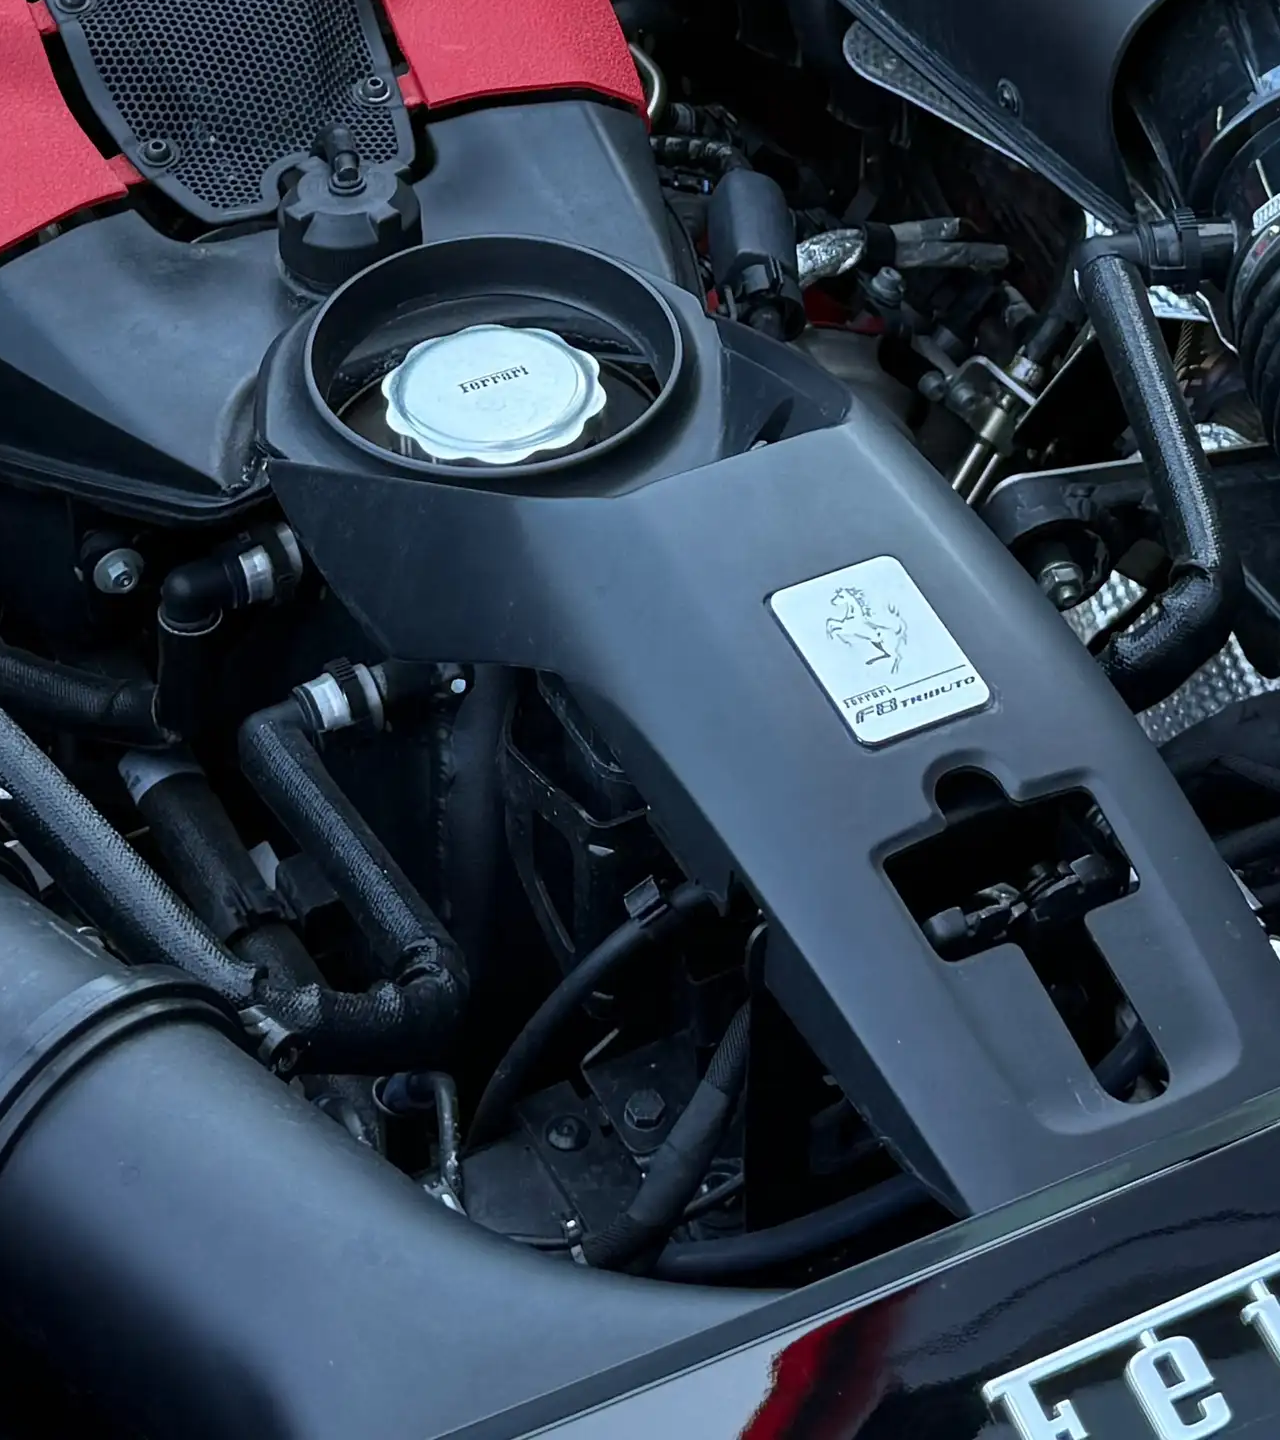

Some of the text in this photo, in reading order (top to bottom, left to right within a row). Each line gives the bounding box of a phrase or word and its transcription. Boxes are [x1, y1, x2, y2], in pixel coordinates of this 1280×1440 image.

[457, 365, 530, 394] Ferrari
[842, 685, 892, 709] Ferrari
[855, 698, 898, 724] F8
